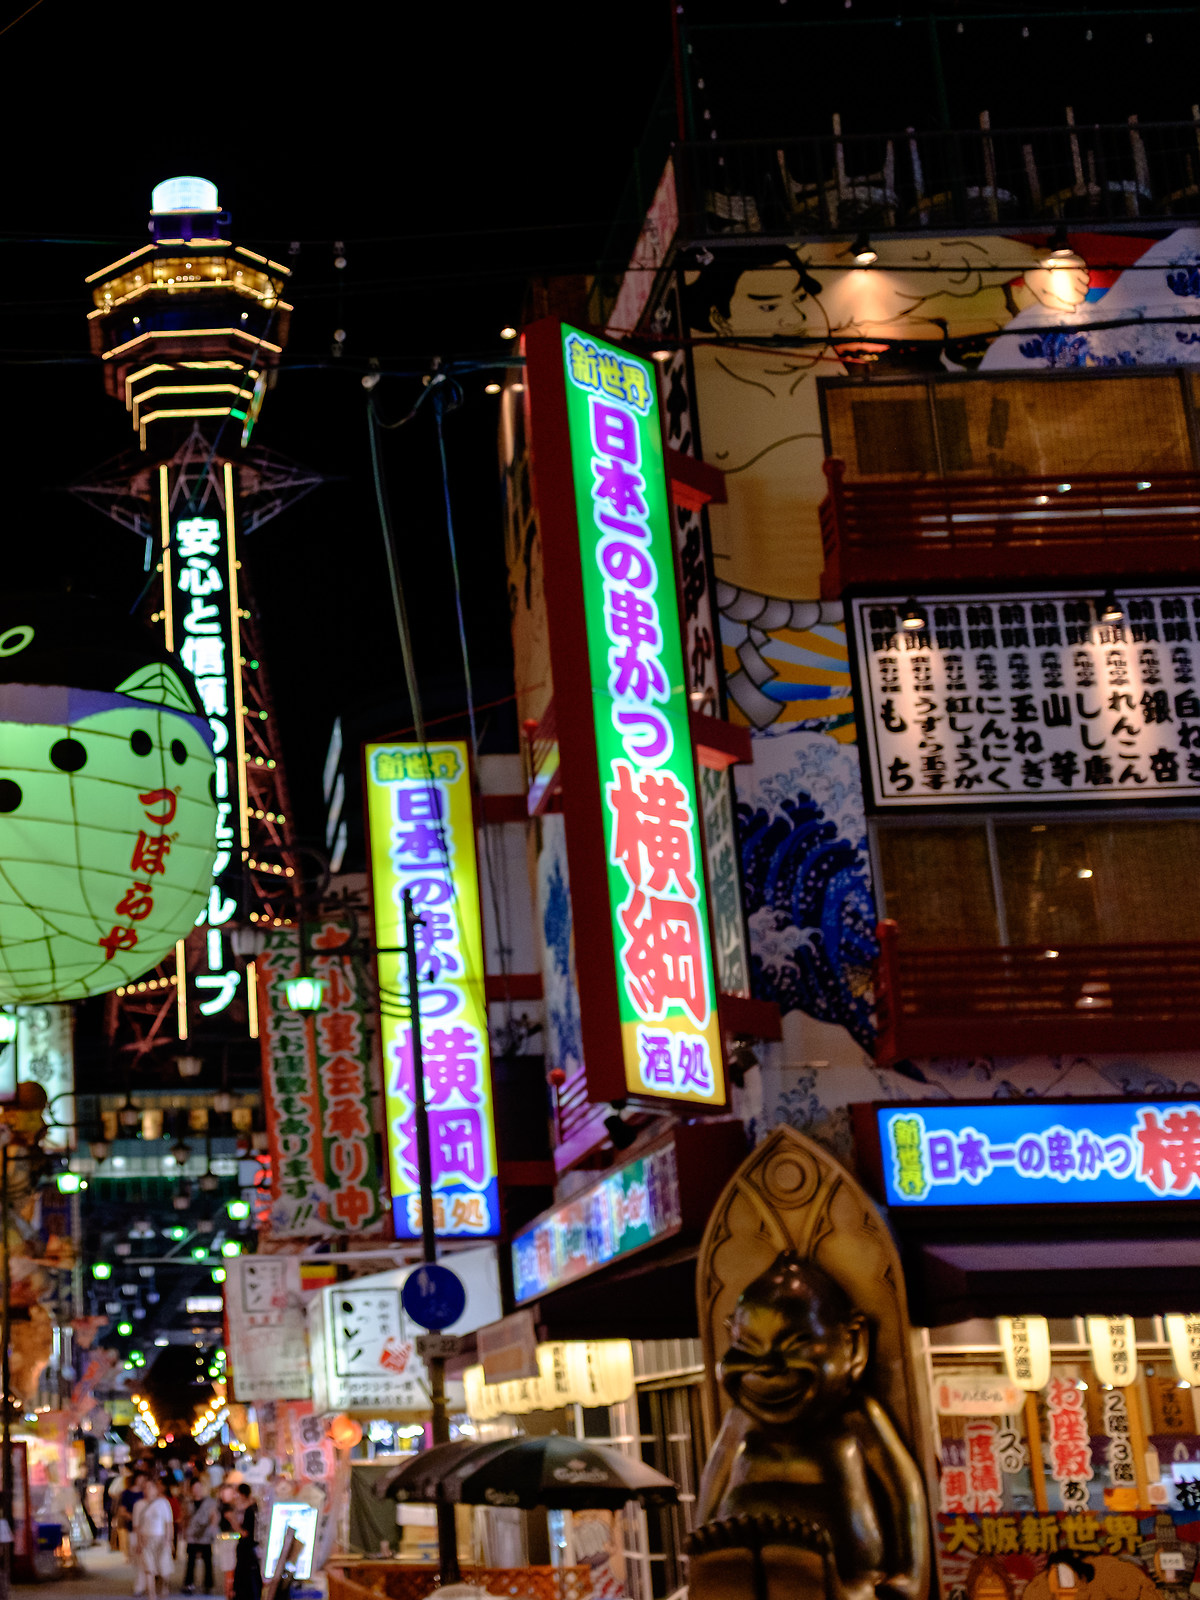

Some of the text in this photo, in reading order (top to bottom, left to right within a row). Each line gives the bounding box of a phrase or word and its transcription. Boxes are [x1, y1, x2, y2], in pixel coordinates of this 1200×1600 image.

[567, 337, 651, 411] 新世界
[592, 400, 707, 1026] 日本一の串かつ 横綱
[881, 699, 913, 791] もち
[976, 697, 1011, 788] にんにく
[1010, 694, 1046, 787] 玉ねぎ
[1108, 691, 1147, 783] れんこん
[176, 517, 241, 1017] 安心と信頼ループ
[100, 786, 182, 960] づぼらや
[641, 1032, 710, 1090] 酒処
[929, 1131, 1132, 1179] 日本一の串かつ
[945, 1515, 1143, 1554] 大阪新世界
